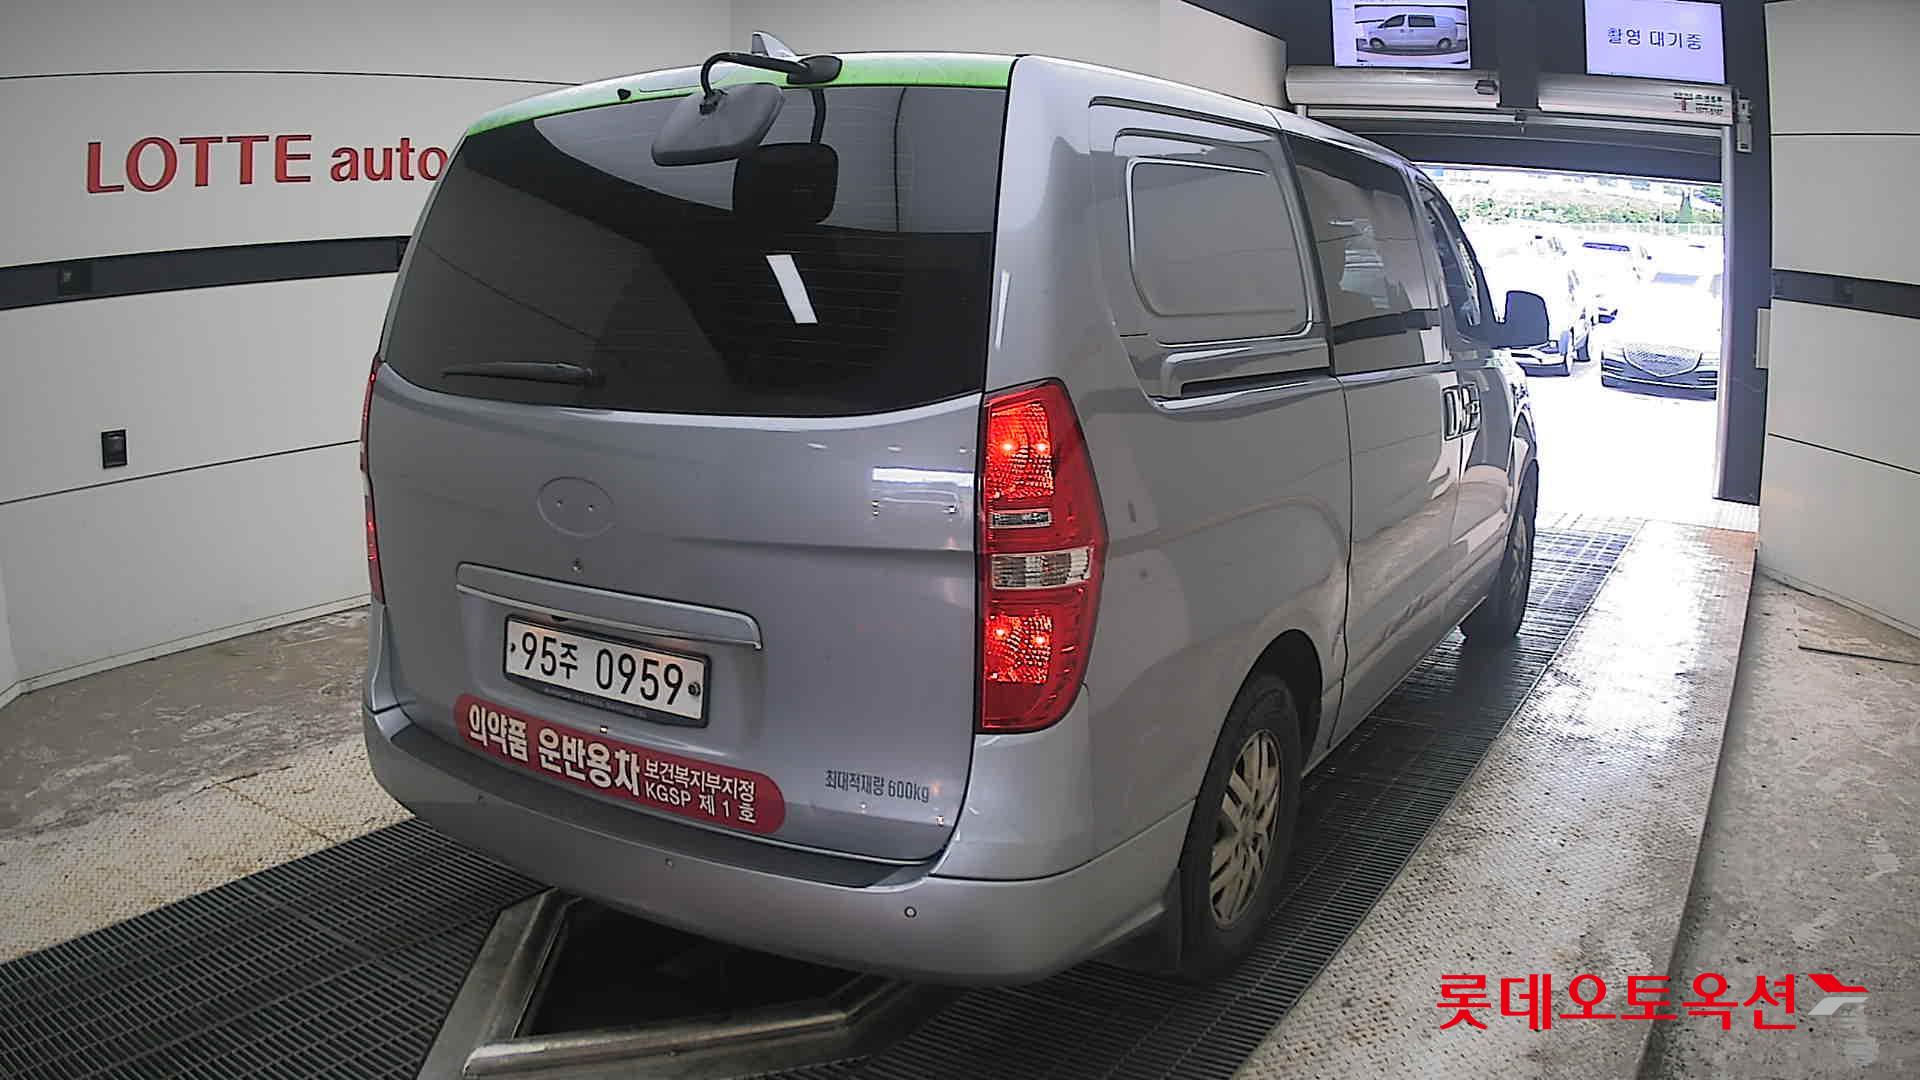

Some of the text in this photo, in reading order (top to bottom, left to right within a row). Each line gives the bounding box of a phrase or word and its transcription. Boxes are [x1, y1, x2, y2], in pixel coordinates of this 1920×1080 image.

[1649, 31, 1702, 50] 대기중
[87, 134, 449, 194] LOTTE auto
[521, 631, 578, 679] 95주
[596, 648, 683, 705] 0959
[468, 704, 641, 797] 의약품 운반용차
[645, 759, 755, 802] 보건복지부지정
[825, 769, 930, 803] 최대적재량 600kg
[645, 781, 756, 824] KGSP 제 1 호
